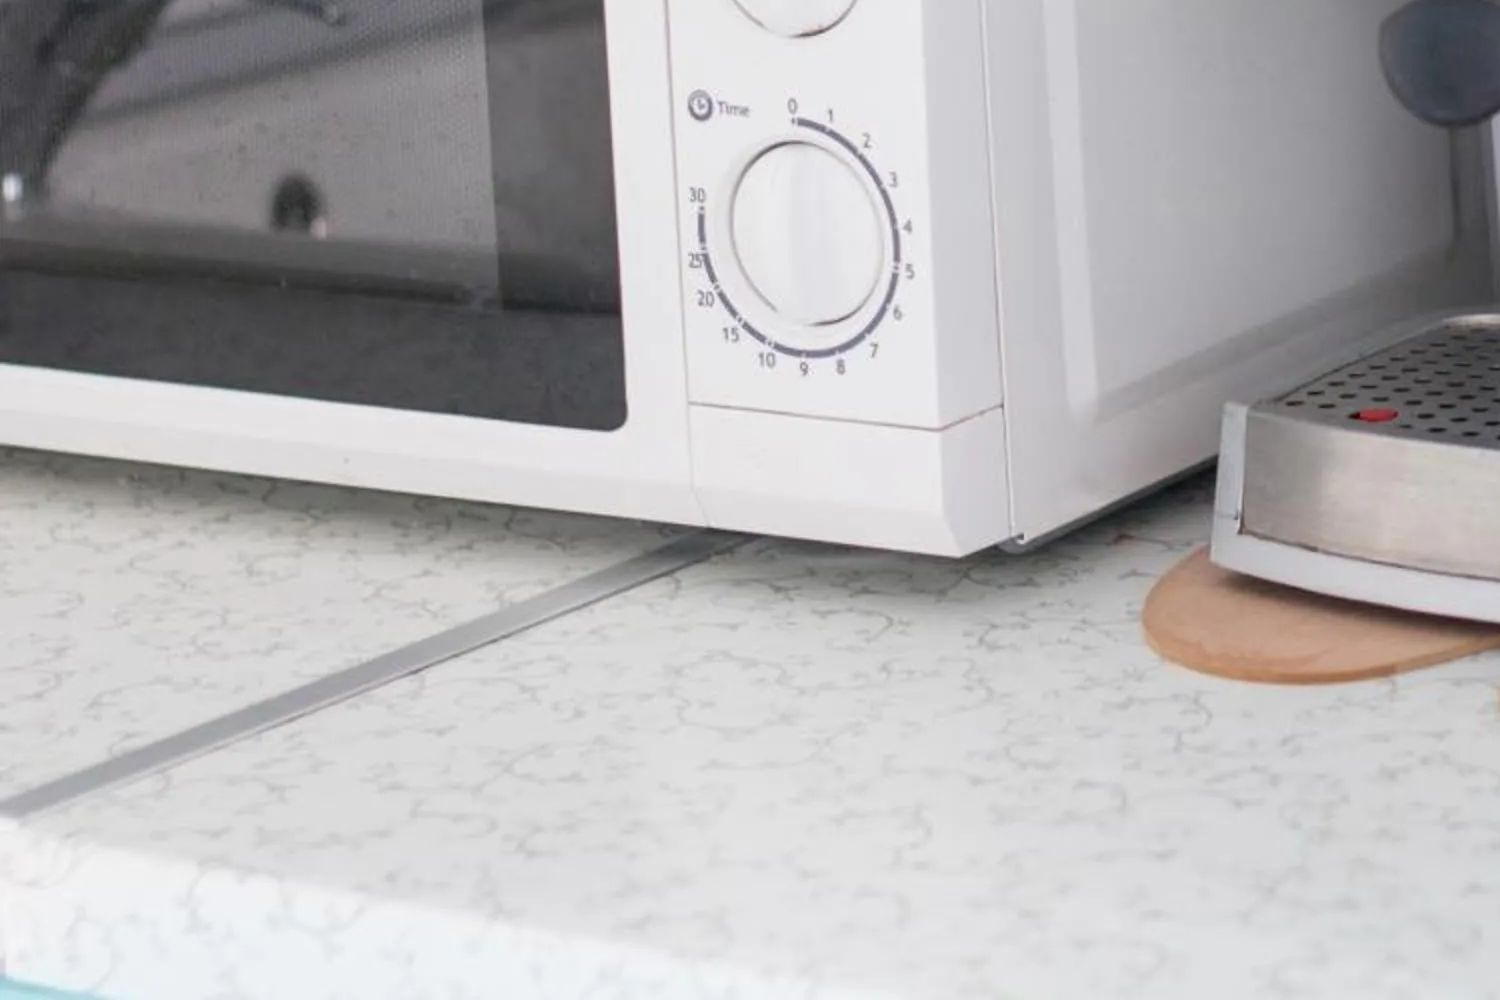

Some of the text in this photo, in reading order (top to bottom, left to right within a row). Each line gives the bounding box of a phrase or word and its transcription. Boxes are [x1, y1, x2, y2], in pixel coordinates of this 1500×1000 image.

[717, 101, 749, 118] Time
[787, 97, 798, 115] 0
[826, 109, 834, 123] 1
[862, 132, 872, 149] 2
[889, 171, 898, 187] 3
[689, 187, 706, 204] 30
[903, 219, 913, 235] 4
[688, 252, 705, 269] 25
[905, 264, 915, 280] 5
[697, 290, 715, 308] 20
[893, 304, 903, 321] 6
[723, 327, 740, 343] 15
[870, 343, 879, 359] 7
[759, 352, 777, 369] 10
[836, 360, 846, 376] 8
[799, 362, 809, 377] 9
